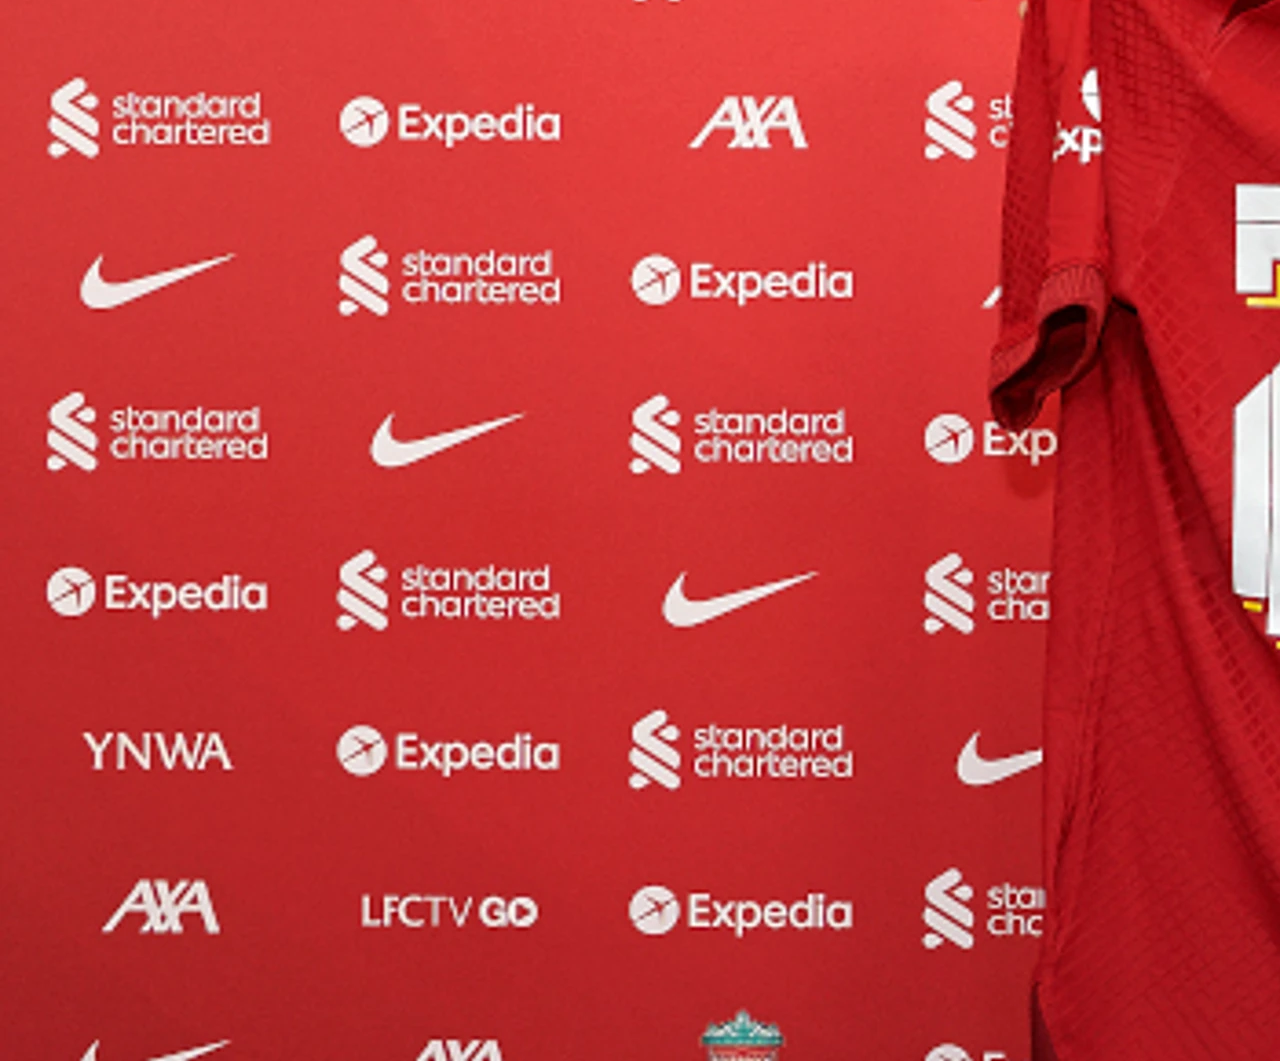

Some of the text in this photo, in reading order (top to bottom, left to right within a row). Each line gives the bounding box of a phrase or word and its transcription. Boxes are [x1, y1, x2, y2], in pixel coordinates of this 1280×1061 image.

[113, 92, 260, 118] standard
[113, 118, 270, 144] chartered
[398, 103, 560, 148] Expedia
[689, 96, 808, 149] AXA
[403, 250, 552, 277] standard
[402, 277, 560, 304] chartered
[691, 262, 852, 306] Expedia
[110, 406, 260, 433] standard
[695, 409, 844, 435] standard
[110, 433, 267, 459] chartered
[695, 436, 852, 462] chartered
[402, 565, 549, 592] standard
[106, 575, 267, 618] Expedia
[402, 592, 560, 619] chartered
[84, 733, 232, 770] YNWA
[695, 725, 842, 751] standard
[397, 733, 559, 777] Expedia
[695, 751, 852, 777] chartered
[103, 880, 219, 934] AXA
[479, 896, 538, 927] GO
[689, 894, 852, 937] Expedia
